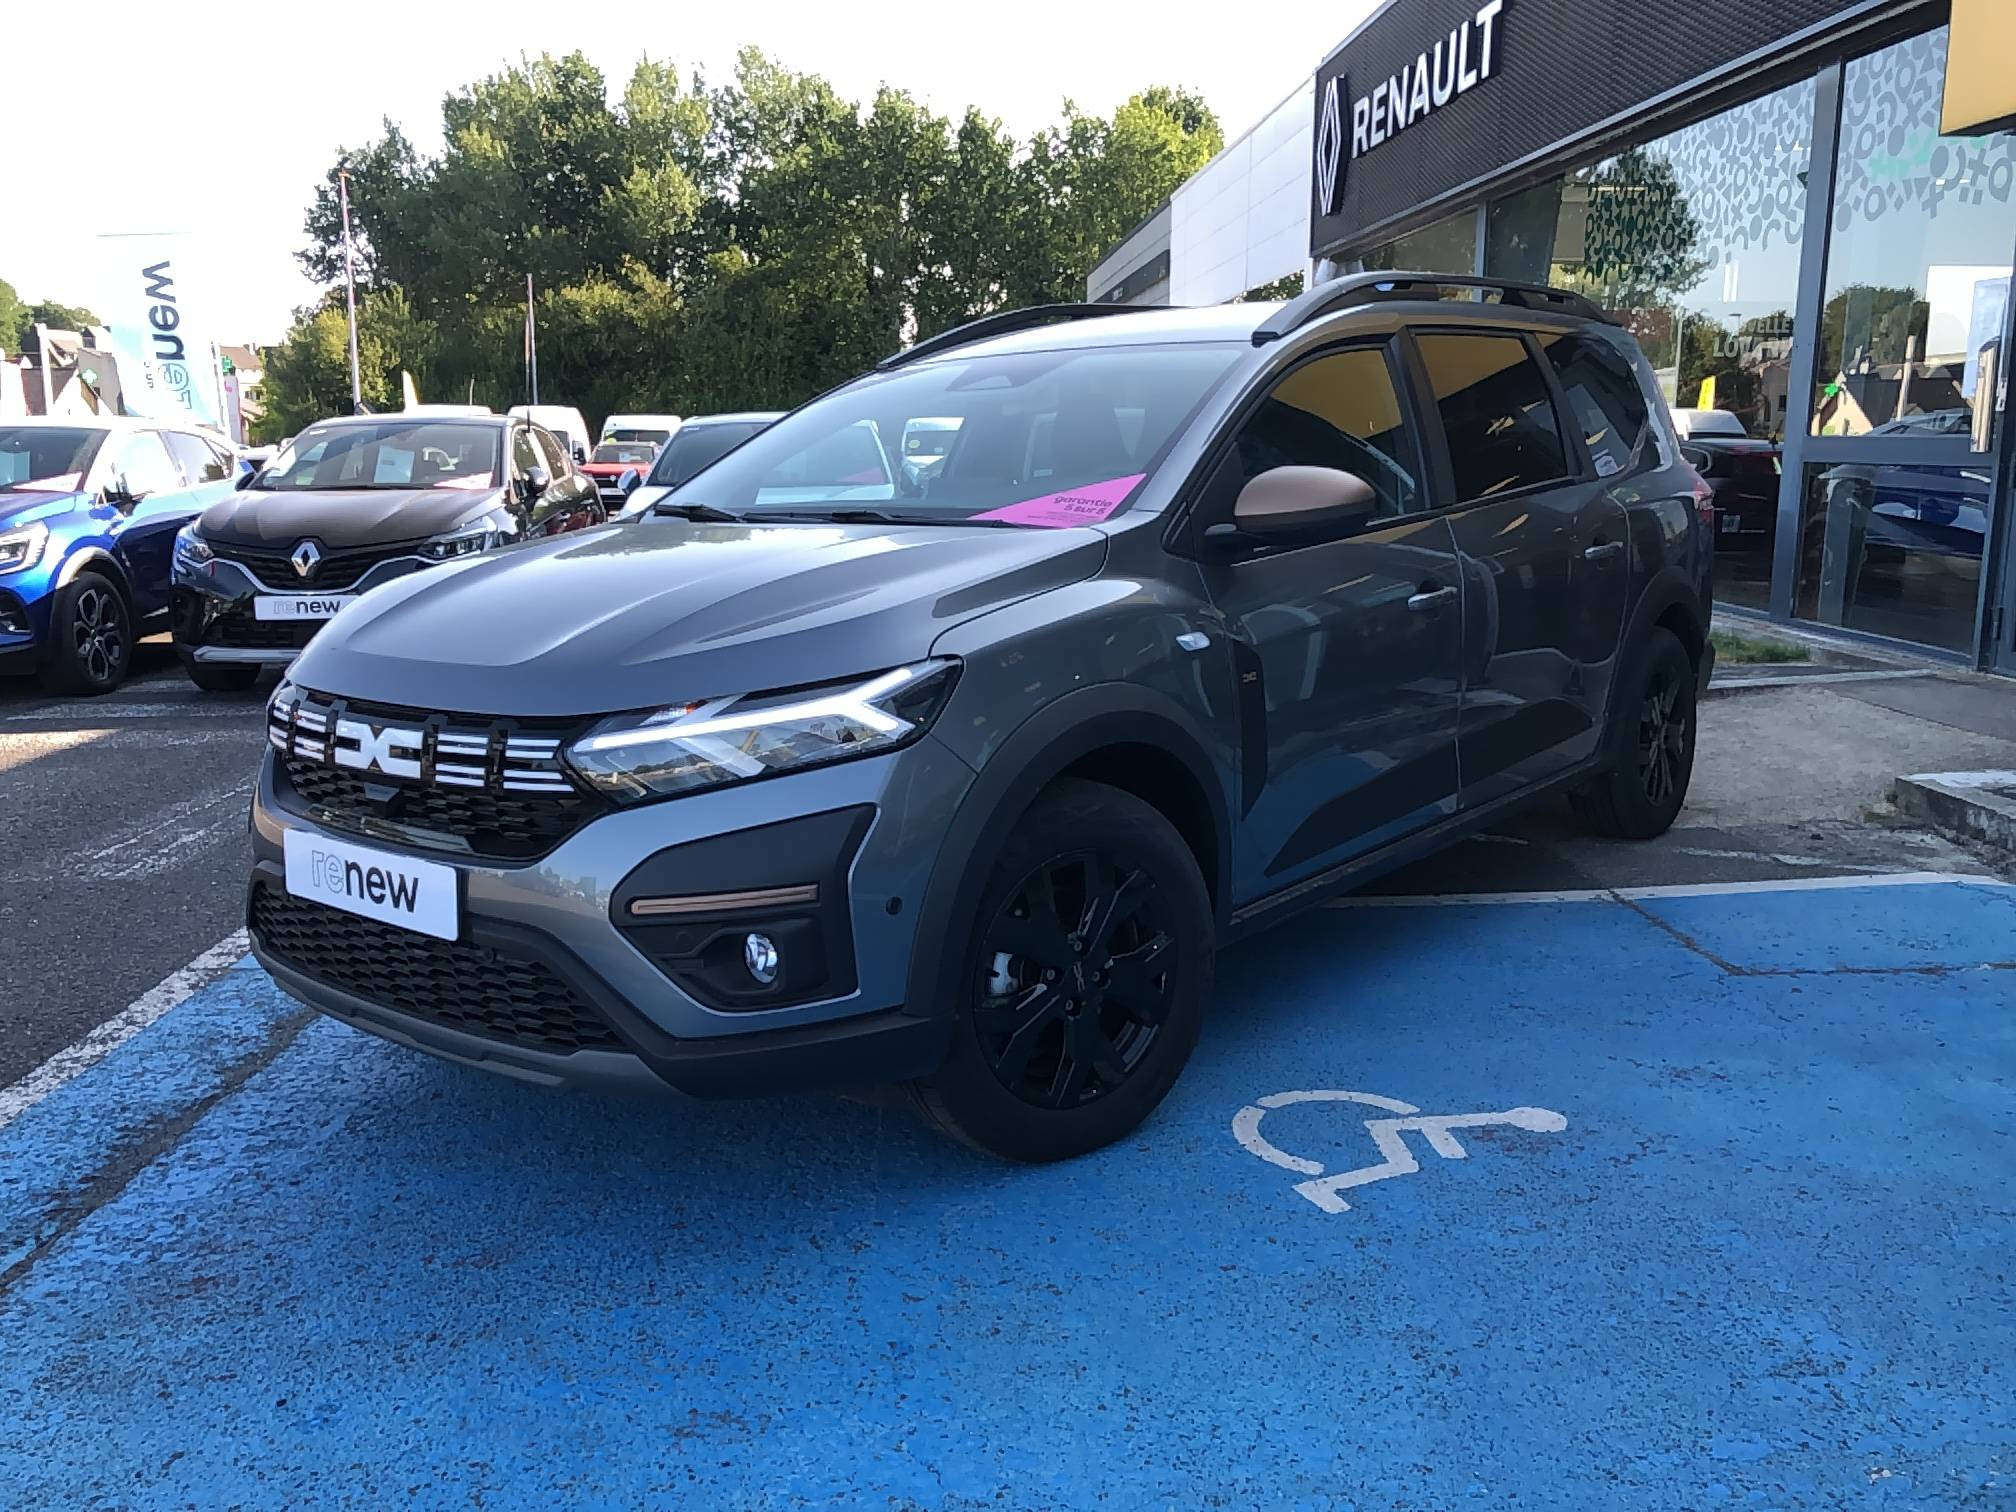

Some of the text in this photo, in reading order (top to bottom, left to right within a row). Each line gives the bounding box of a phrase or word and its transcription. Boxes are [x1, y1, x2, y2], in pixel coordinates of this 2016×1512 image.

[1352, 0, 1503, 159] RENAULT
[142, 260, 192, 409] renew
[273, 599, 341, 614] renew
[311, 849, 419, 913] renew
